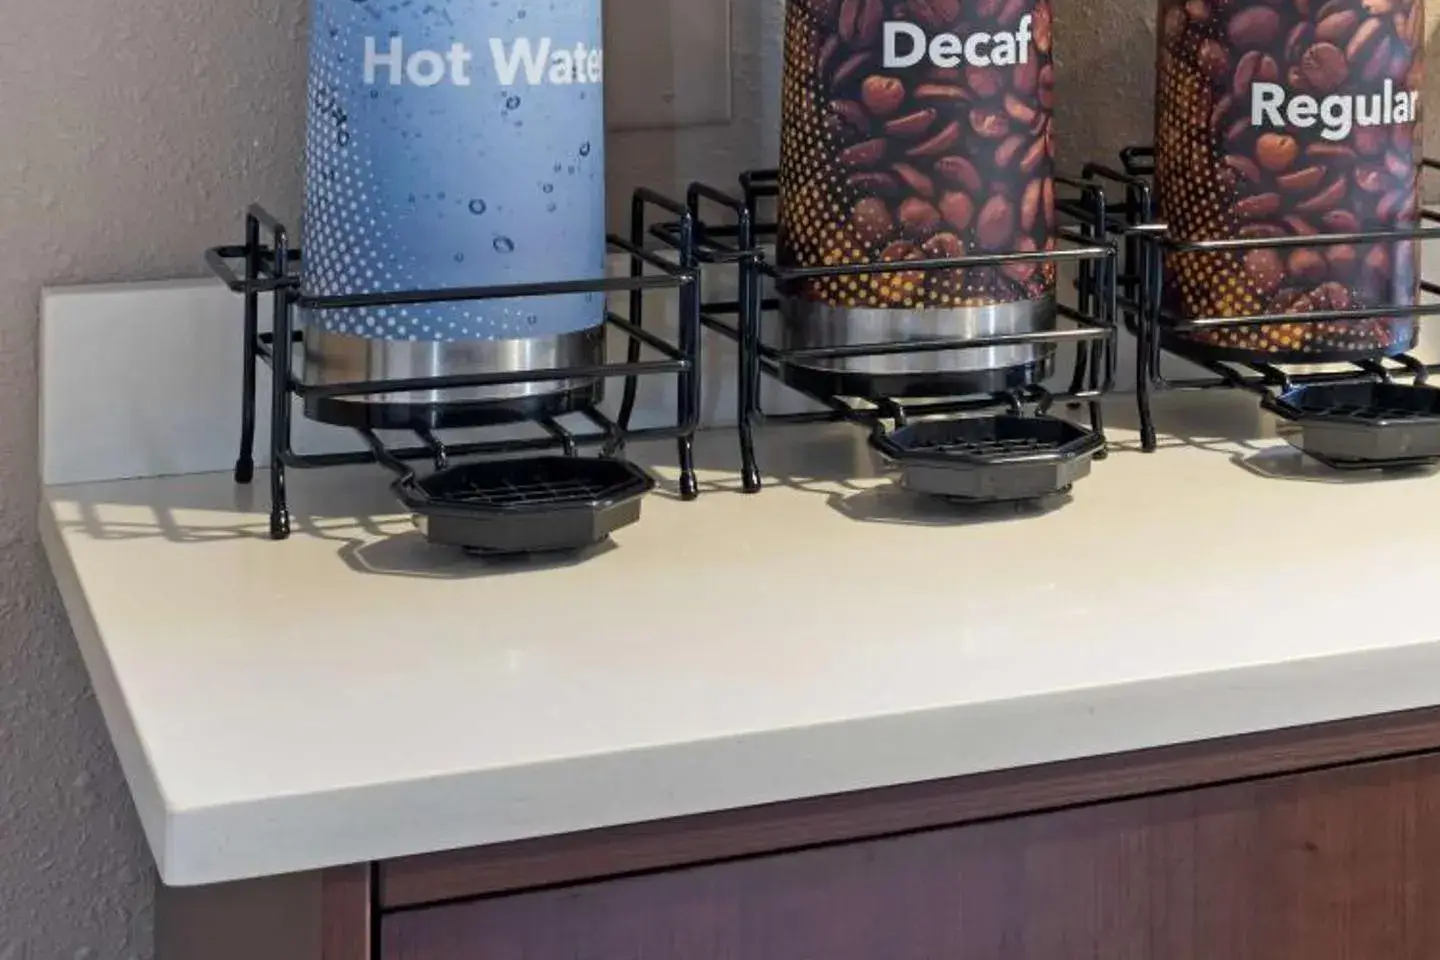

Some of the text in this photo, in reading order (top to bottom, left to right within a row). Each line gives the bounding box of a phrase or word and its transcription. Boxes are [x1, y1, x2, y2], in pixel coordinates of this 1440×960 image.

[363, 35, 603, 87] Hot Wate
[883, 14, 1032, 69] Decaf
[1251, 78, 1419, 141] Regular
